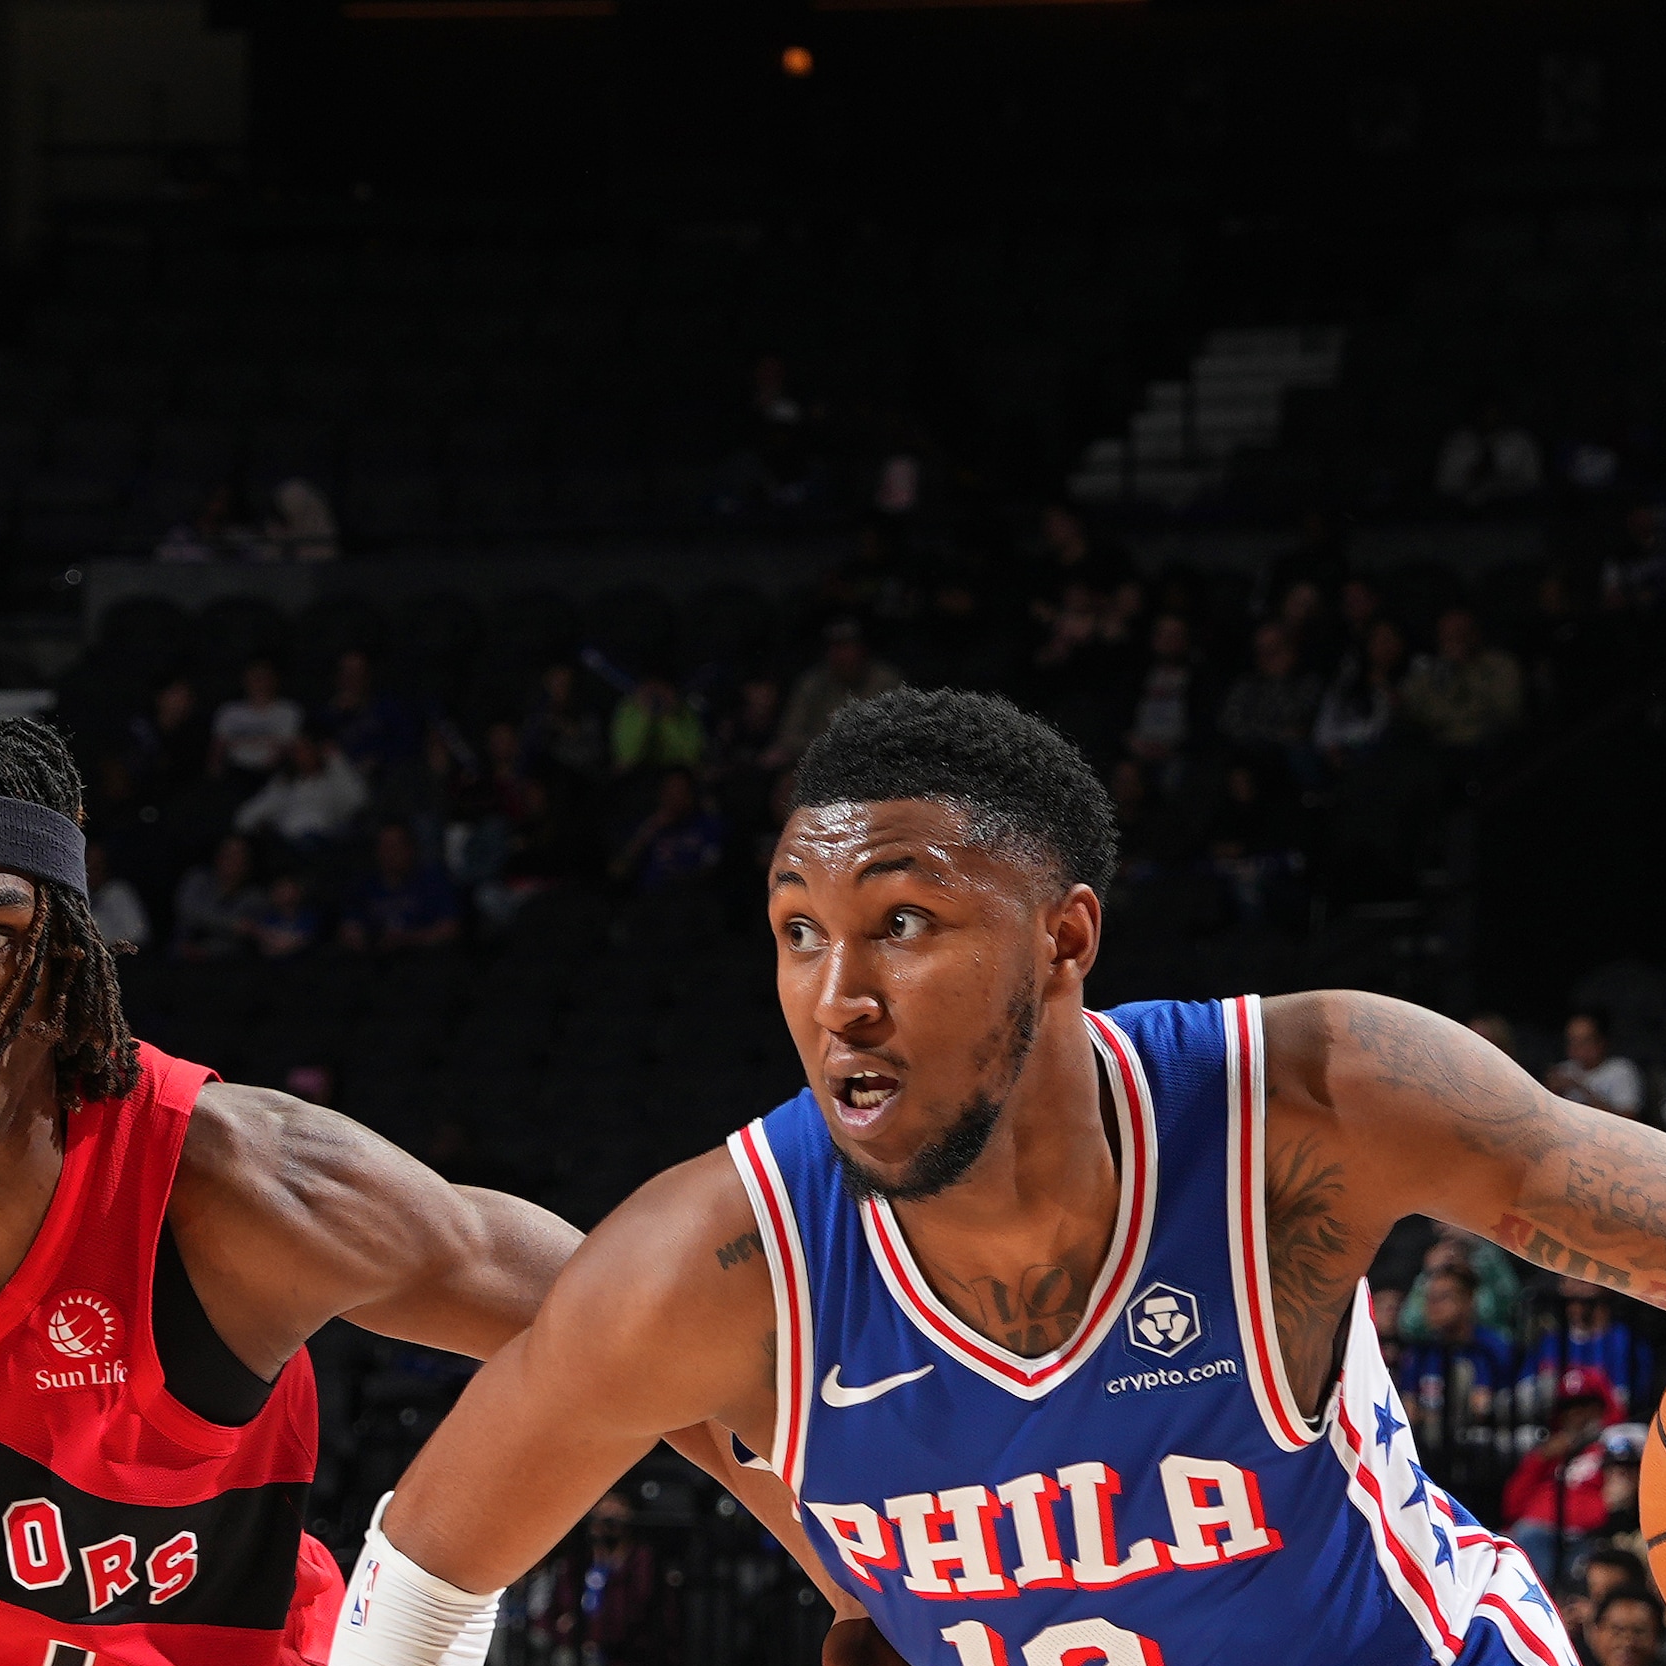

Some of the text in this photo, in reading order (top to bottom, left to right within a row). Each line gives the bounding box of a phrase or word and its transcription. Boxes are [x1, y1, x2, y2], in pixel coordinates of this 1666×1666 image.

[35, 1369, 86, 1390] Sun
[1106, 1358, 1237, 1395] crypto.com
[804, 1455, 1283, 1600] PHILA
